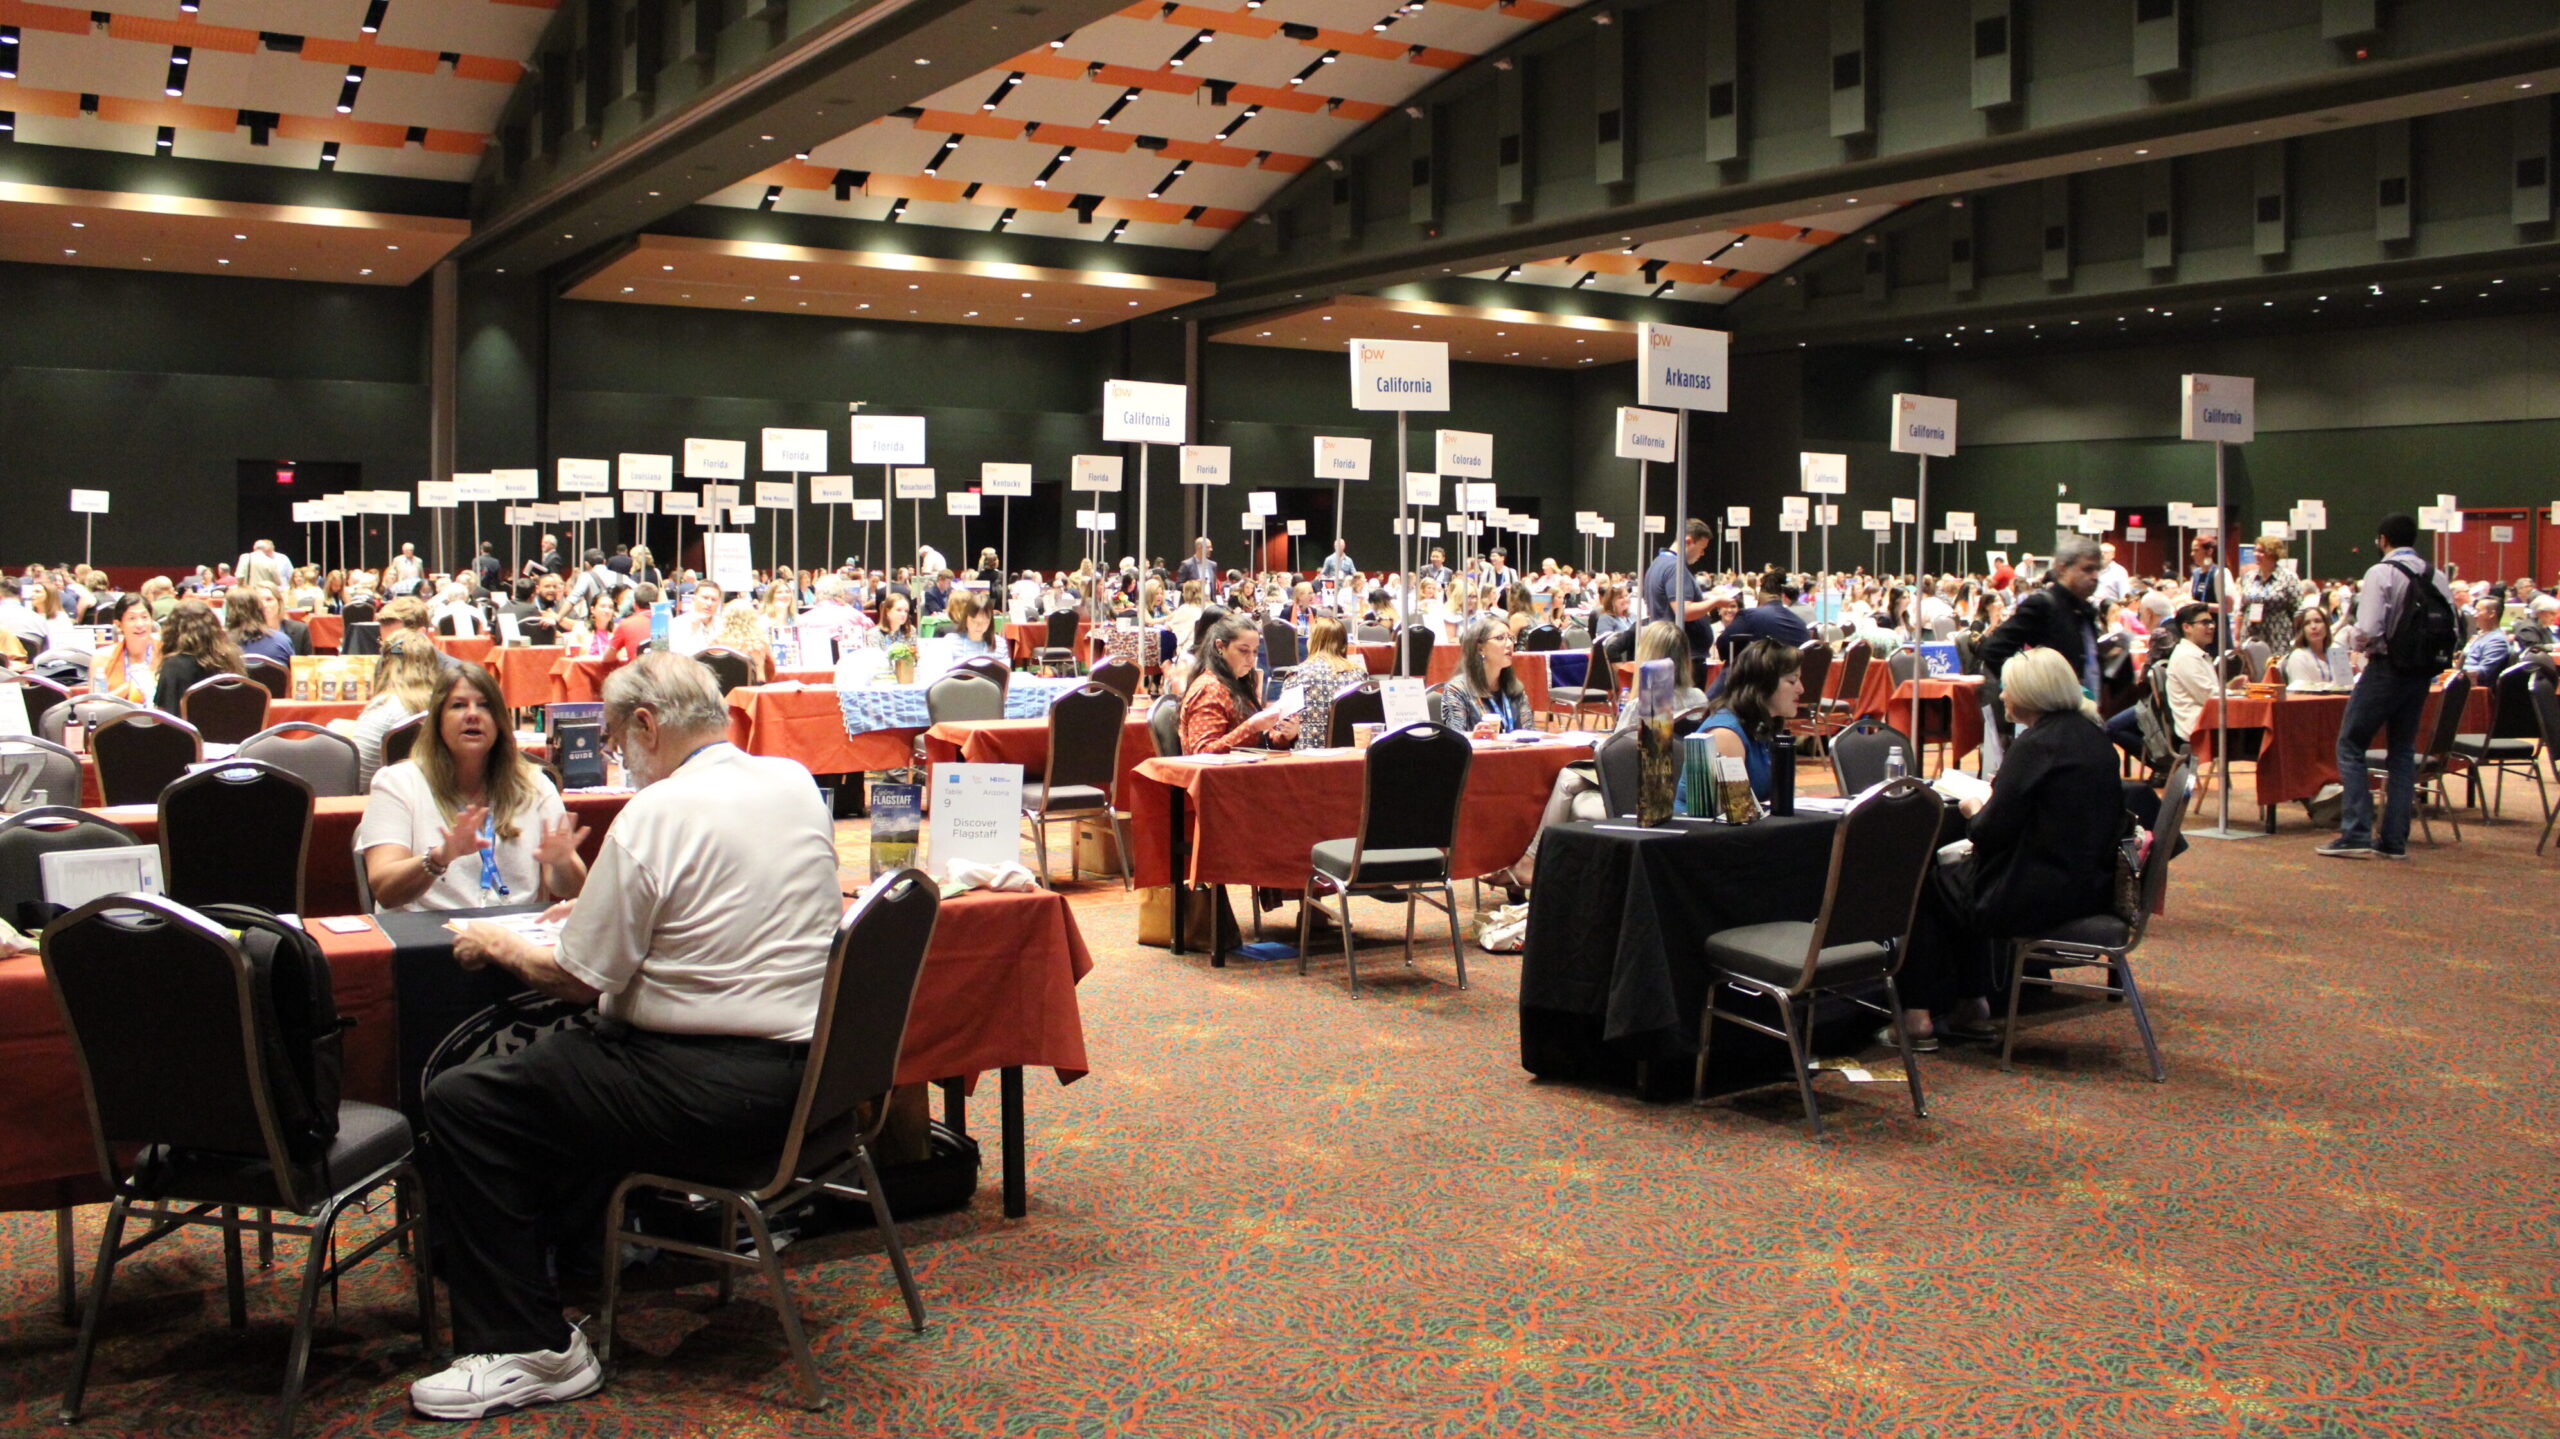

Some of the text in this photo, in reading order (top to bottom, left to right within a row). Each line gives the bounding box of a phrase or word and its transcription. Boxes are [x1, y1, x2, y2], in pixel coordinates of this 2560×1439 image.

[1650, 328, 1673, 350] ipw
[1360, 344, 1385, 363] ipw
[1665, 367, 1711, 390] Arkansas
[1377, 376, 1432, 393] California
[1123, 411, 1170, 427] California
[2203, 408, 2242, 424] California
[1909, 424, 1945, 440] California
[873, 440, 905, 452] Florida
[1632, 433, 1665, 448] California
[782, 450, 810, 461] Florida
[1452, 454, 1482, 466] Colorado
[703, 459, 729, 469] Florida
[1197, 464, 1218, 474] Florida
[1333, 458, 1356, 469] Florida
[631, 472, 661, 481] Louisiana
[1088, 473, 1109, 482] Florida
[1815, 473, 1838, 483] California
[993, 479, 1021, 489] Kentucky
[822, 489, 842, 497] Nevada
[569, 752, 593, 760] GUIDE
[983, 789, 1010, 797] Arizona
[873, 794, 912, 805] FLAGSTAFF
[944, 799, 952, 808] 9
[953, 817, 998, 828] Discover
[952, 829, 998, 840] Flagstaff
